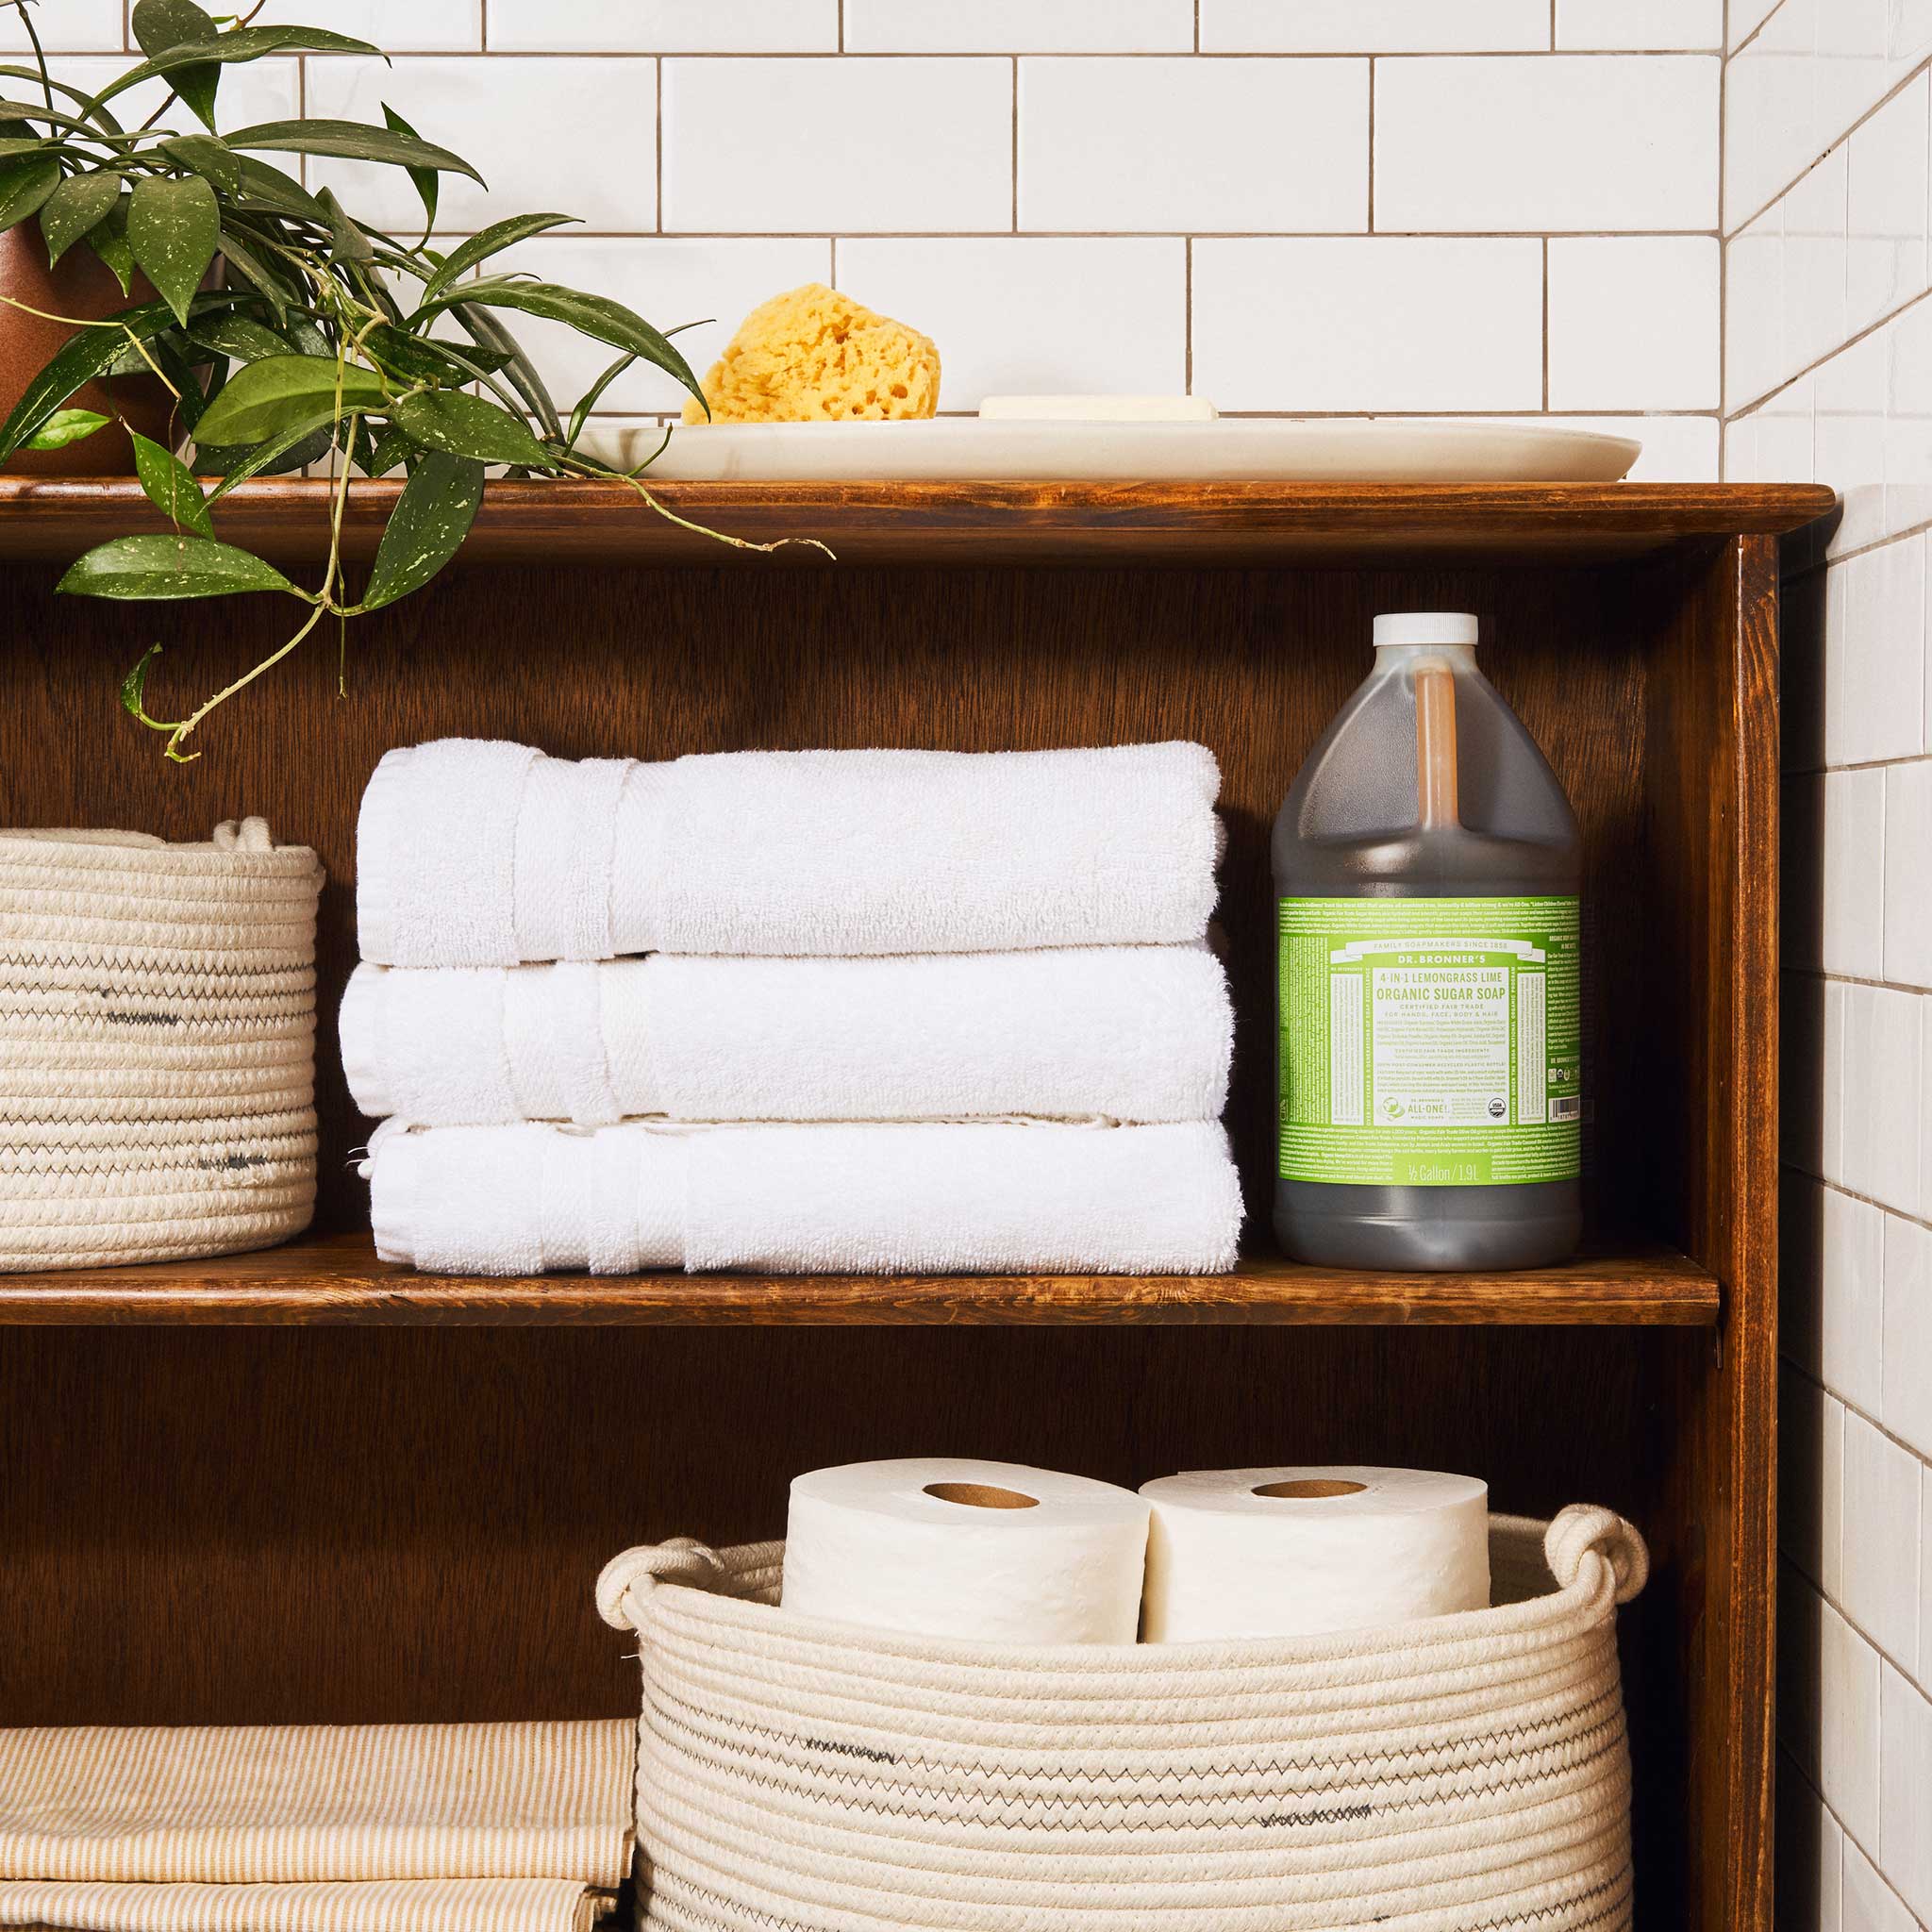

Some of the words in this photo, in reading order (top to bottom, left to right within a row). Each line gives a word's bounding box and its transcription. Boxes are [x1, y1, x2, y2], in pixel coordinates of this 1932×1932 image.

[1398, 955, 1417, 964] DR.
[1419, 955, 1486, 964] BRONNER'S
[1412, 973, 1478, 983] LEMONGRASS
[1481, 972, 1503, 982] LIME
[1376, 988, 1430, 1001] ORGANIC
[1433, 988, 1474, 1001] SUGAR
[1476, 987, 1506, 1000] SOAP
[1407, 1105, 1448, 1113] ALL-ONE!
[1420, 1163, 1450, 1181] Gallon
[1458, 1163, 1479, 1181] 1.9L
